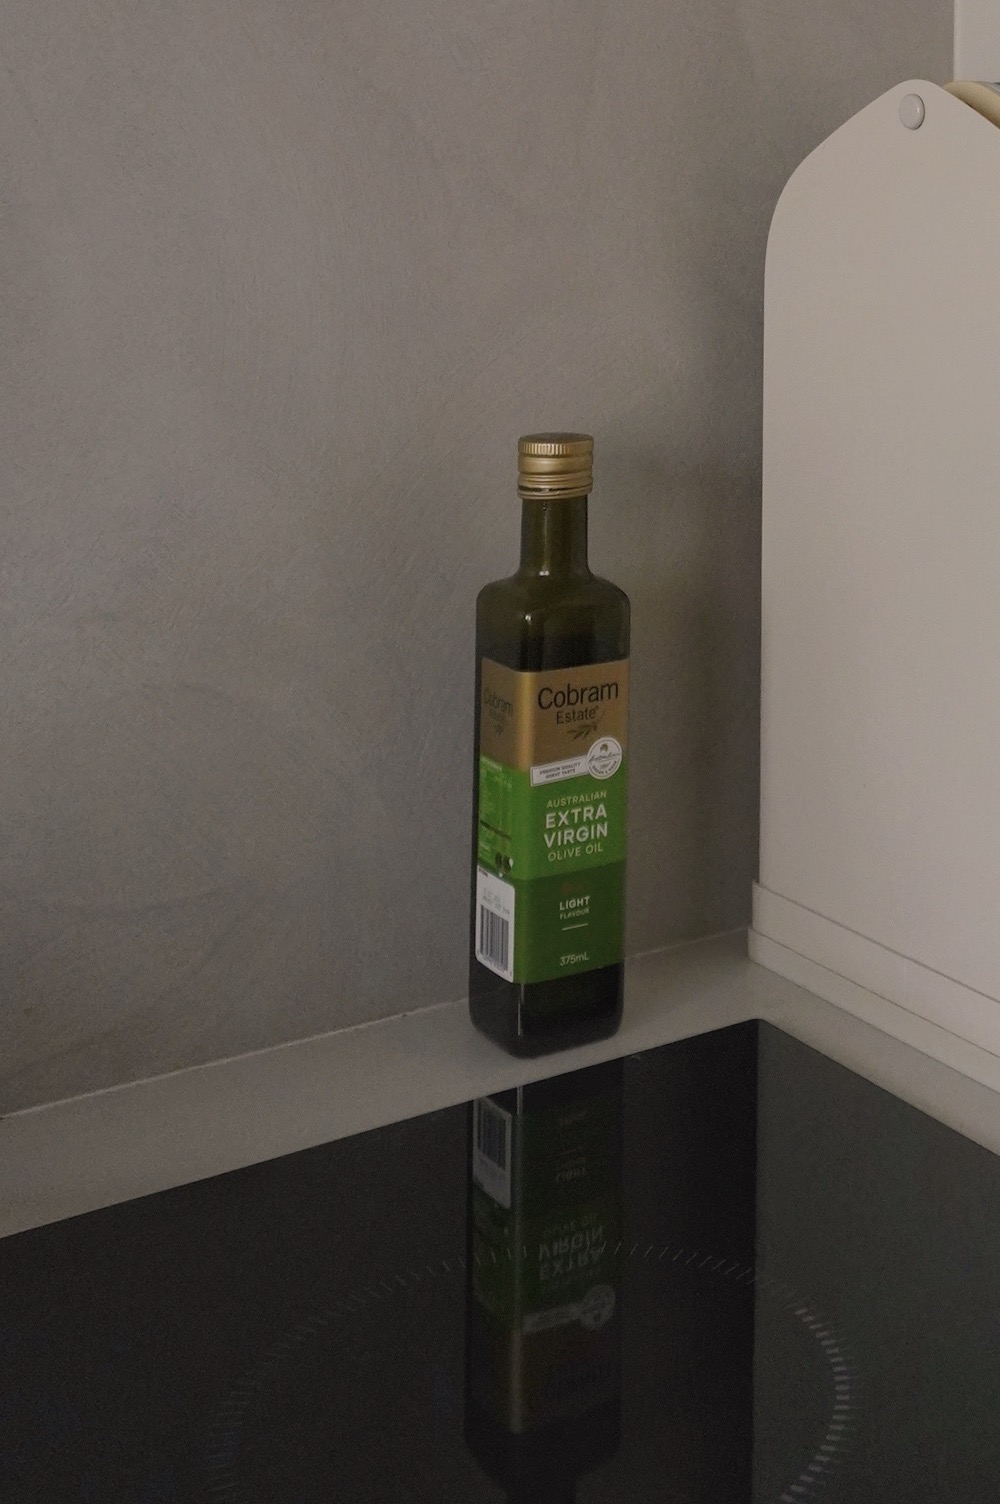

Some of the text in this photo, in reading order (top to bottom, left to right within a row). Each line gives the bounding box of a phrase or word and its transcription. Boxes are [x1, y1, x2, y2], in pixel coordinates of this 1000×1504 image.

[537, 682, 619, 710] Cobram
[556, 707, 598, 724] Estate
[546, 791, 608, 809] AUSTRALIAN
[545, 803, 608, 829] EXTRA
[544, 822, 608, 848] VIRGIN
[547, 843, 604, 862] OLIVE OIL
[559, 896, 591, 911] LIGHT
[559, 907, 590, 920] FLAVOUR
[559, 951, 590, 967] 375mL
